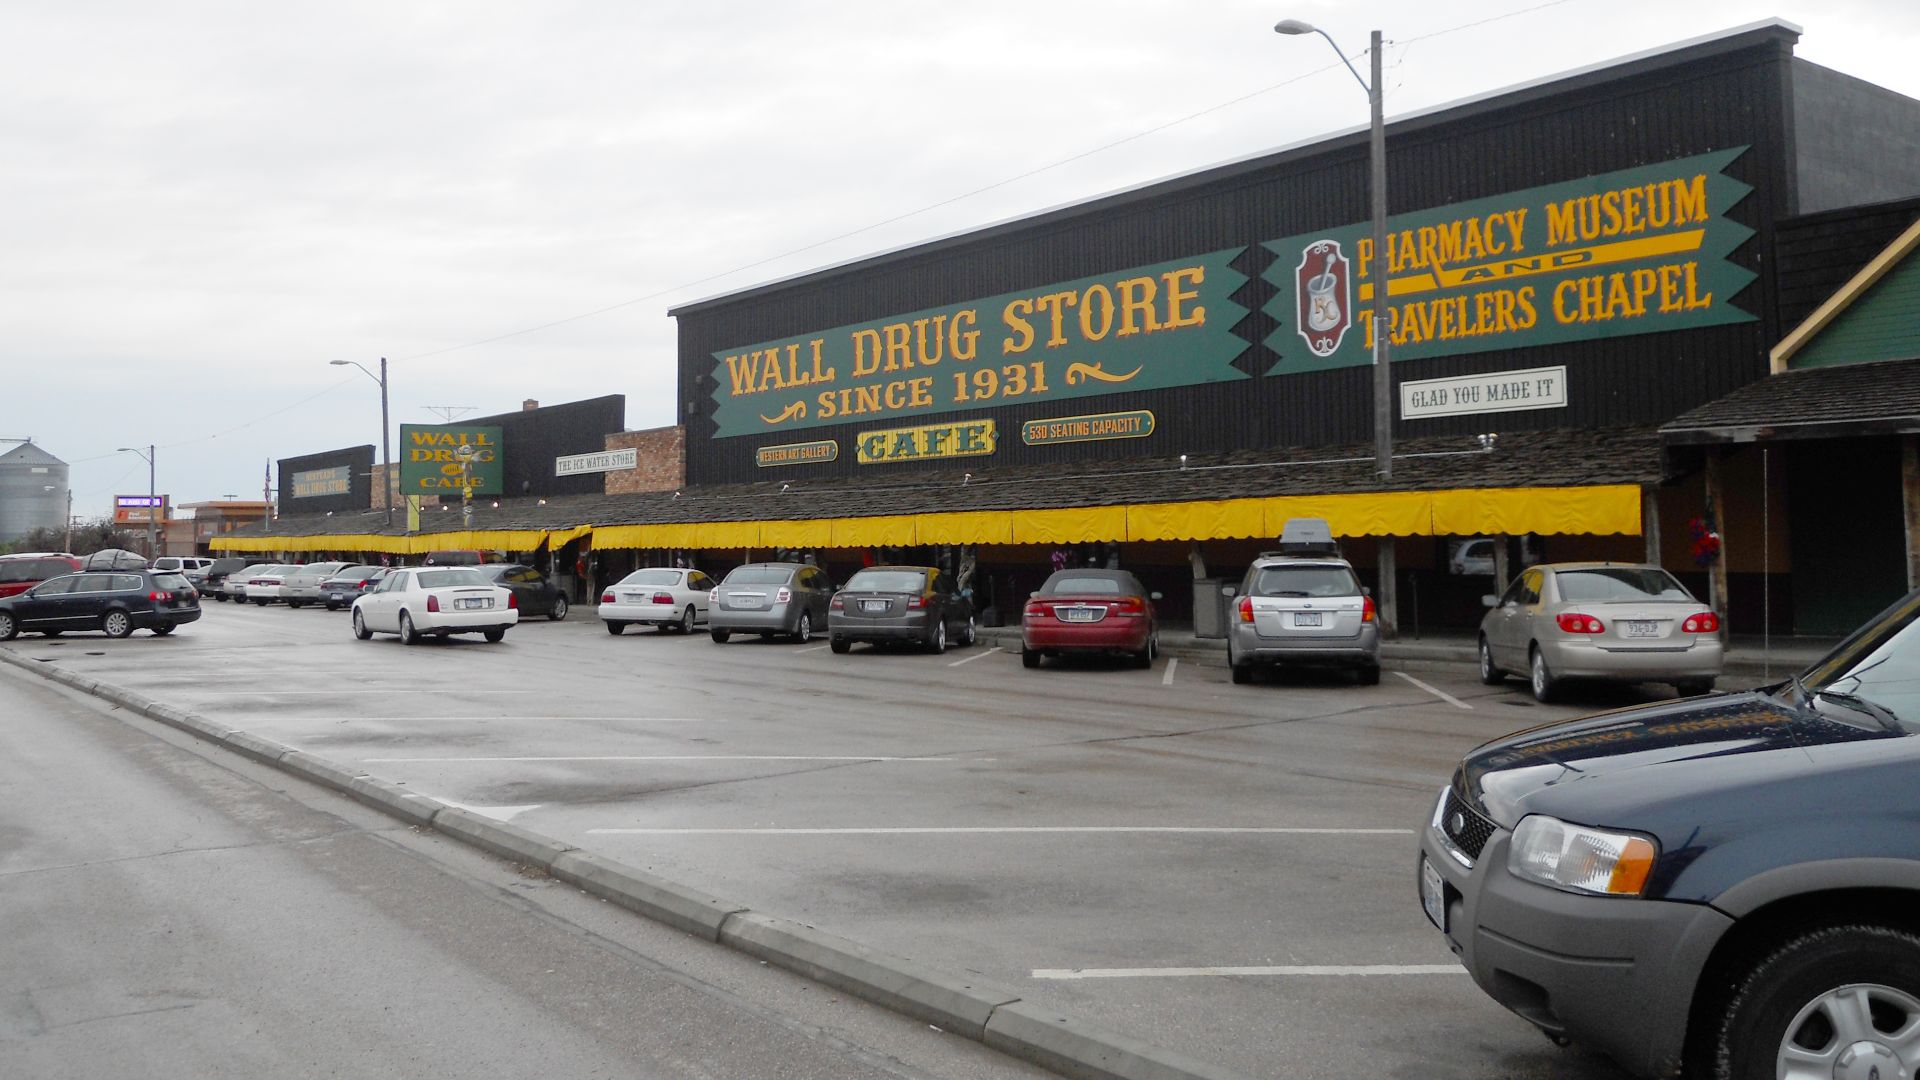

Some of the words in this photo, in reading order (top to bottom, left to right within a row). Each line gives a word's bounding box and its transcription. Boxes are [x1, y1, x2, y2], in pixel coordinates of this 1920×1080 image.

[1545, 172, 1709, 246] MUSEUM
[1461, 251, 1592, 281] AND
[1552, 261, 1712, 325] CHAPEL
[726, 338, 835, 397] WALL
[851, 309, 981, 378] DRUG
[1002, 265, 1206, 355] STORE
[817, 377, 933, 419] SINCE
[954, 361, 1048, 401] 1931
[1411, 389, 1448, 408] GLAD
[1453, 386, 1480, 404] YOU
[1486, 381, 1530, 402] MADE
[1537, 379, 1554, 397] IT
[410, 431, 496, 446] WALL
[862, 424, 986, 458] CAFE
[1030, 423, 1048, 439] 530
[1050, 420, 1090, 437] SEATING
[1092, 417, 1142, 435] CAPACITY
[410, 448, 496, 463] DRG
[558, 460, 571, 471] THE
[573, 459, 585, 470] ICE
[586, 456, 610, 468] WATER
[612, 453, 635, 465] STORE
[759, 449, 787, 462] WESTERN
[788, 448, 800, 460] ART
[801, 445, 831, 459] GALLERY
